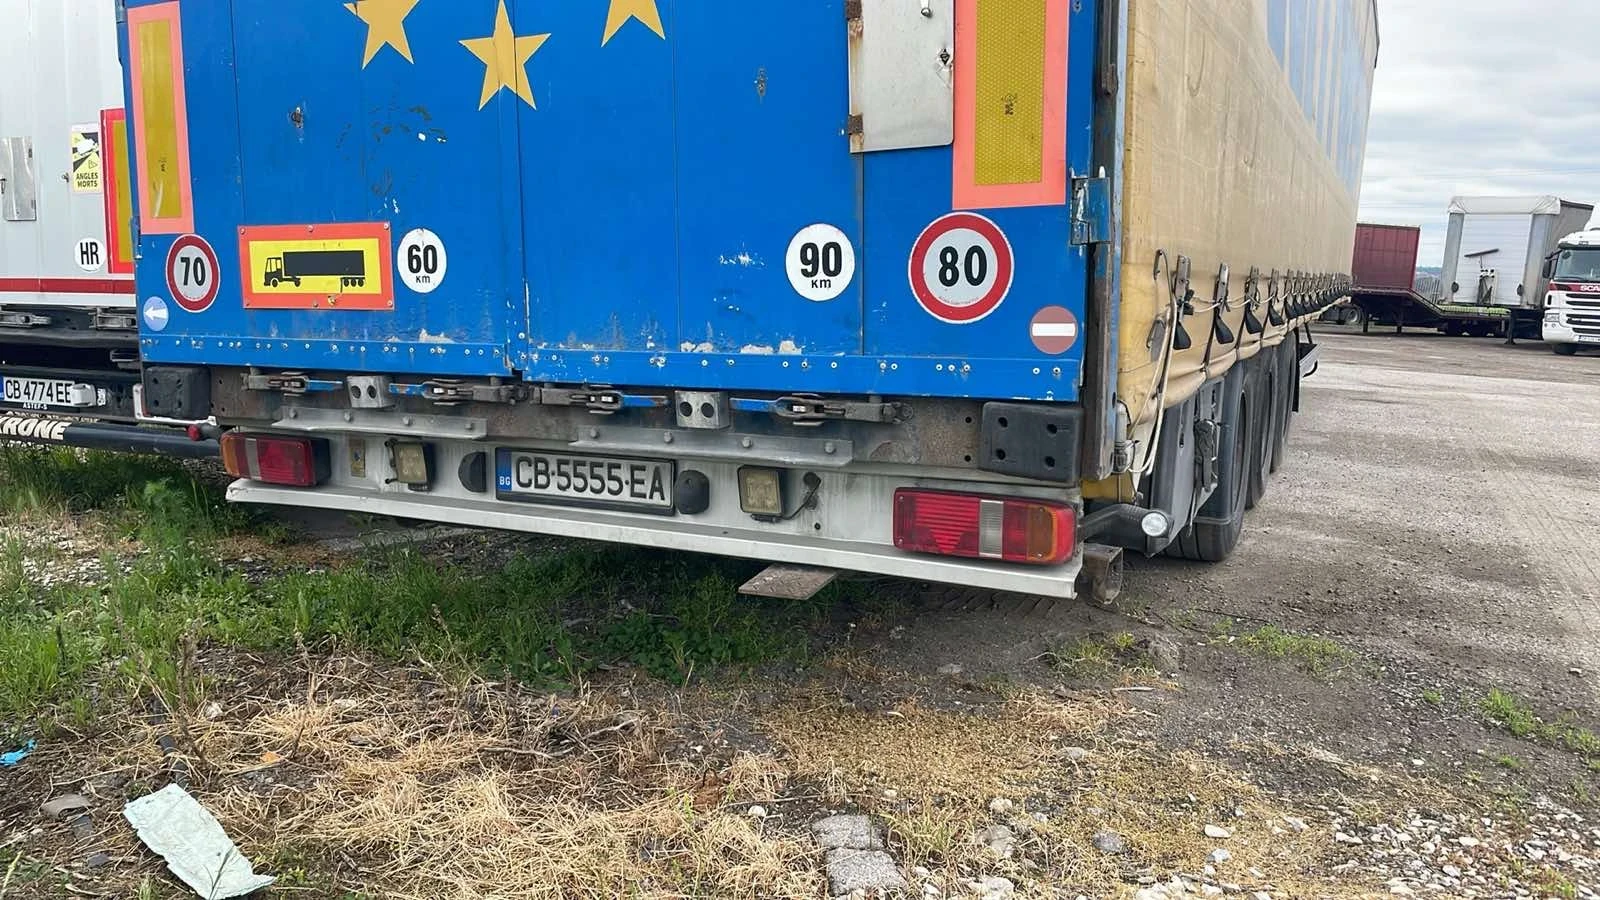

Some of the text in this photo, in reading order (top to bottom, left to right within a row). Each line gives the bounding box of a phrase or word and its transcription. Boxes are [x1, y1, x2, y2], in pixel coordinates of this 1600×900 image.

[76, 172, 99, 180] ANGLES
[77, 180, 98, 188] MORTS
[80, 242, 99, 265] HR
[407, 244, 437, 274] 60
[800, 242, 842, 278] 90
[180, 257, 206, 287] 70
[938, 245, 987, 287] 80
[23, 381, 53, 402] 4774
[499, 476, 511, 486] BG
